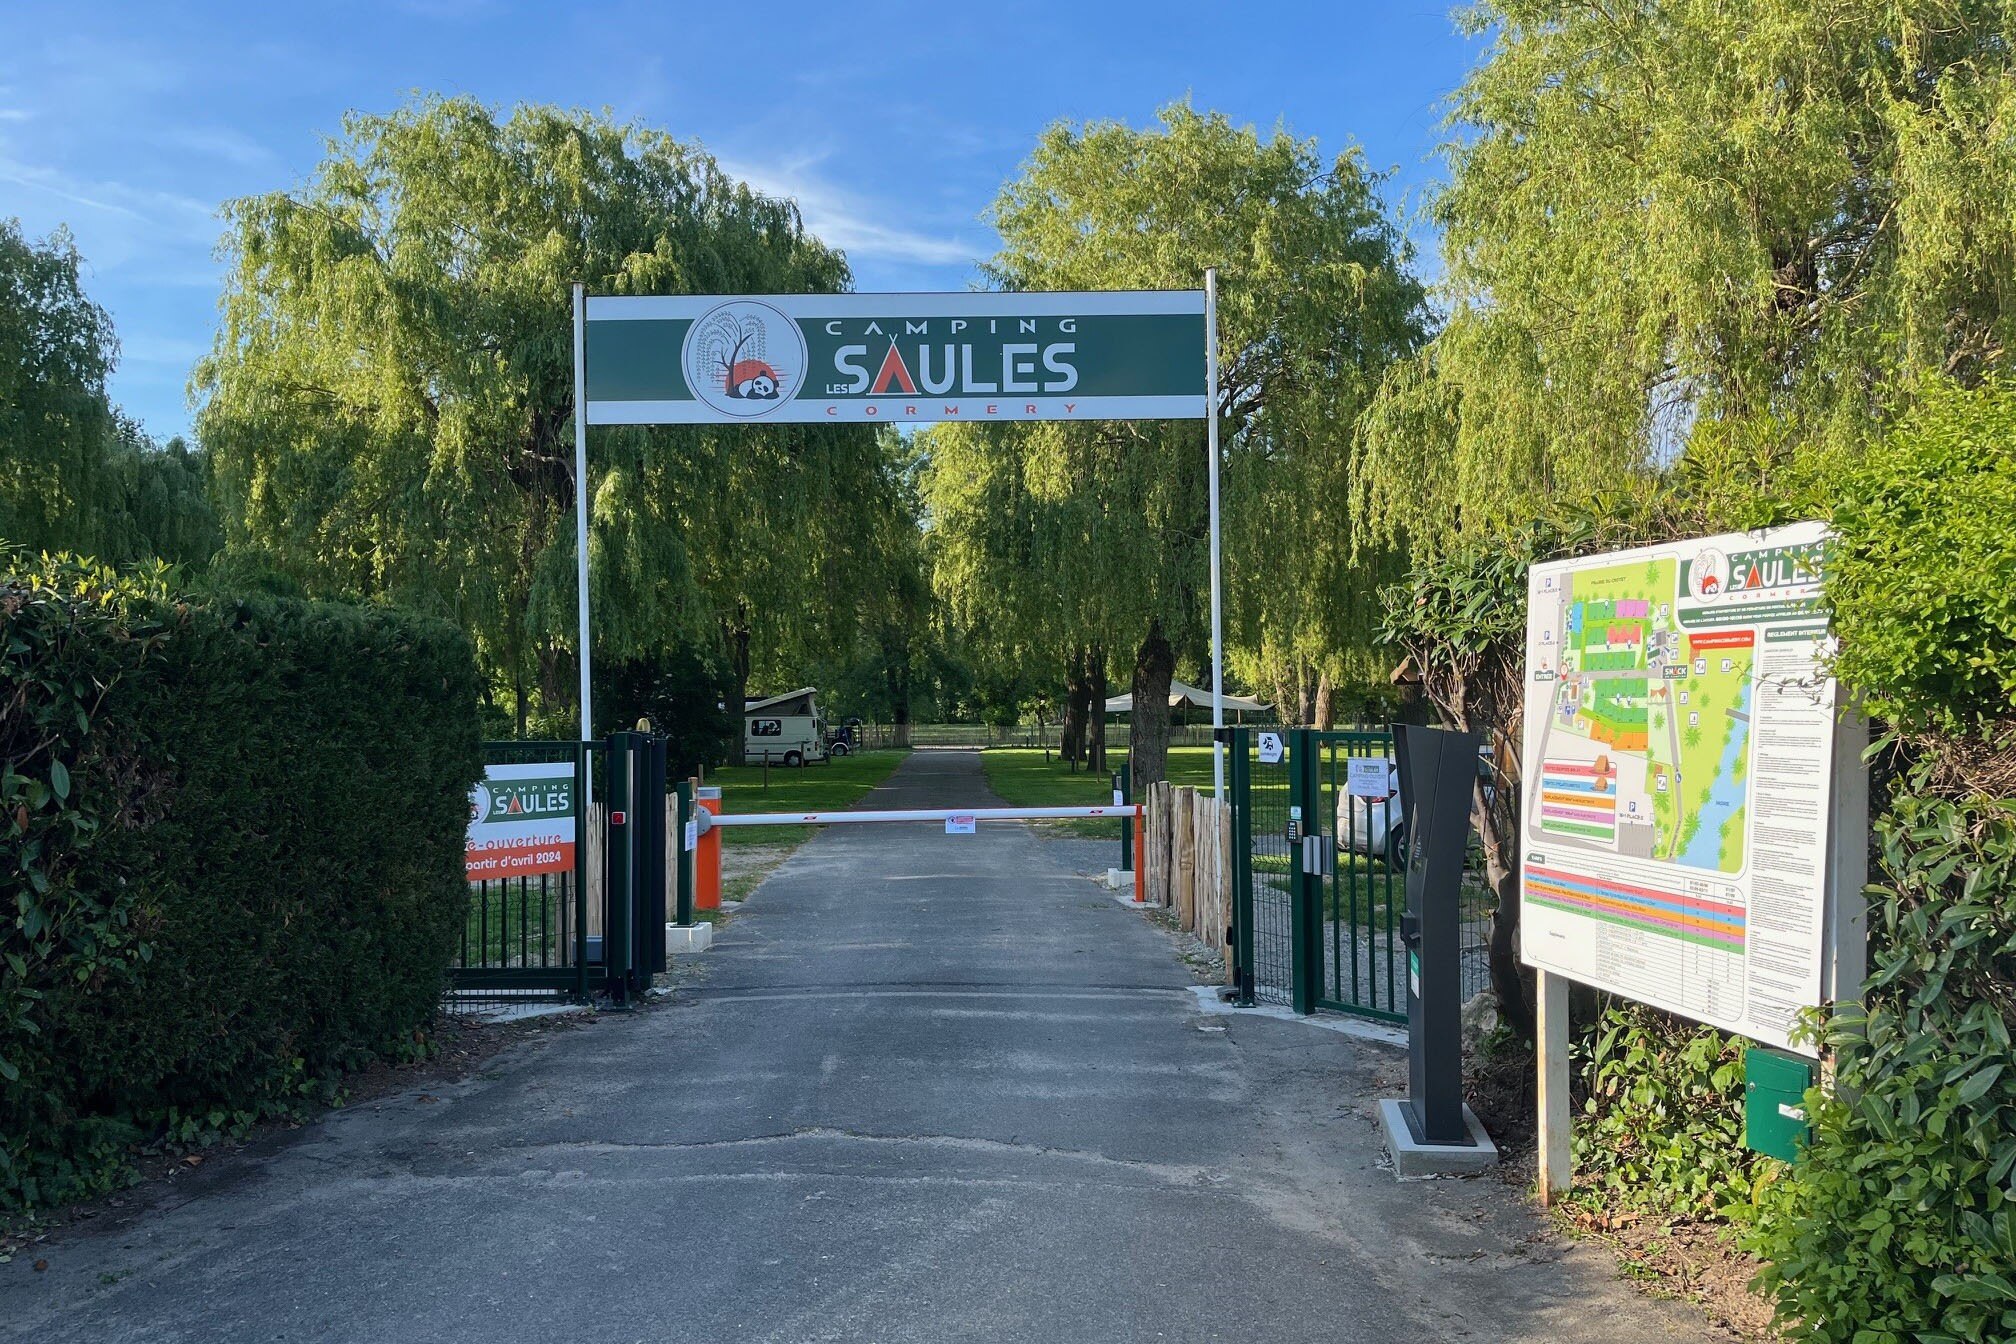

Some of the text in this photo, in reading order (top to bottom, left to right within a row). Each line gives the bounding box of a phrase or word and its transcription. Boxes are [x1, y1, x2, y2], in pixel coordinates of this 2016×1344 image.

[825, 318, 1076, 336] CAMPING
[825, 338, 1079, 396] LES SAULES
[826, 403, 1077, 416] CORMERY
[1731, 542, 1824, 562] CAMPING
[1729, 588, 1806, 601] CORMER
[493, 783, 569, 794] CAMPING
[495, 793, 569, 815] SAULES
[500, 854, 533, 868] d'avril
[536, 850, 562, 864] 2024
